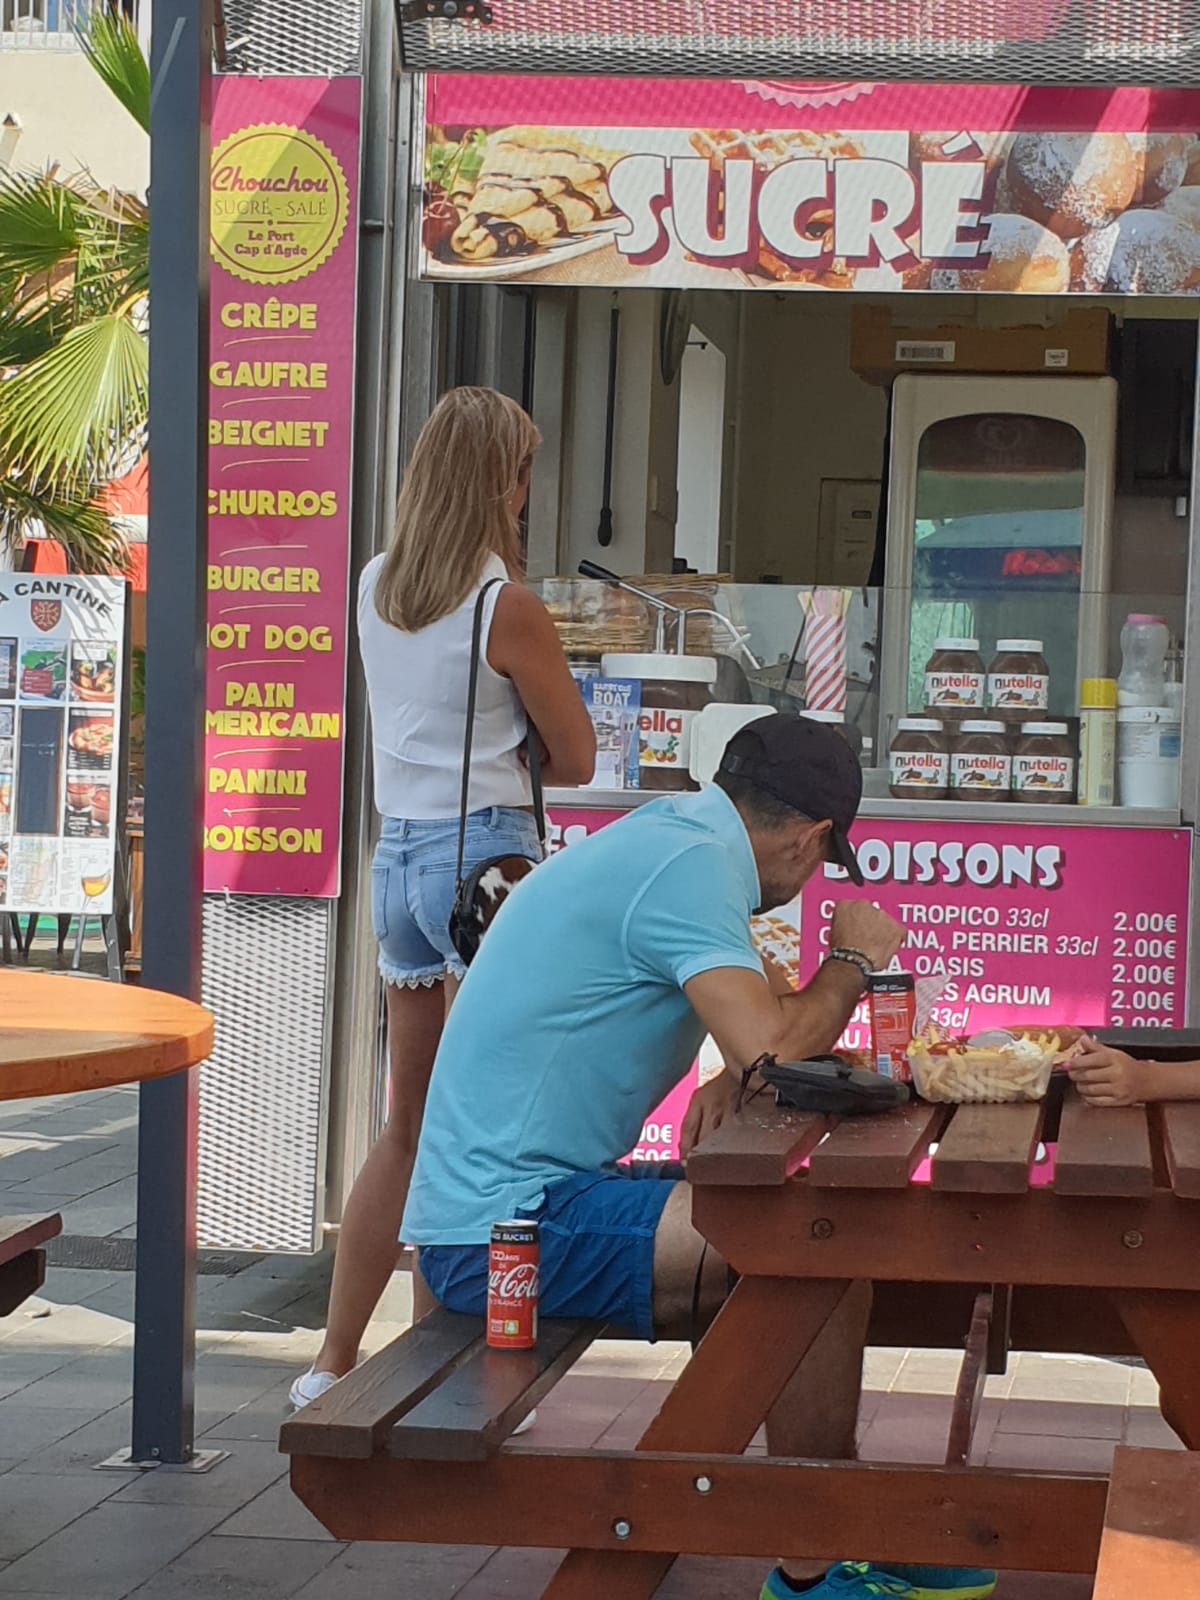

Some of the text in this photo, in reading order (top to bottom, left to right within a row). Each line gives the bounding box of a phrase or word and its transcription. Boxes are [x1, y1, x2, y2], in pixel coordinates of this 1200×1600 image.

[211, 166, 329, 192] Chouchou
[214, 198, 272, 216] SUCRÉ
[286, 198, 328, 216] SALÉ
[606, 129, 990, 266] SUCRÉ
[248, 230, 295, 241] Le Port
[234, 244, 308, 258] Cap d'Agde
[220, 296, 318, 329] CRÊPE
[209, 361, 328, 388] GAUFRE
[208, 419, 329, 447] BEIGNET
[207, 565, 321, 593] BURGER
[14, 581, 113, 618] CANTINE
[207, 622, 333, 651] OT DOG
[931, 675, 979, 688] nutella
[995, 675, 1042, 689] nutella
[225, 681, 295, 708] PAIN
[592, 691, 631, 707] BOAT
[205, 710, 340, 738] MERICAIN
[639, 710, 683, 734] ella
[895, 755, 942, 768] nutella
[958, 757, 1006, 770] nutella
[1019, 759, 1068, 772] nutella
[208, 768, 307, 795] PANINI
[204, 825, 323, 853] OISSON
[898, 903, 1000, 926] TROPICO
[1005, 907, 1050, 928] 33cl
[1113, 911, 1177, 933] 2.00€
[952, 932, 1049, 954] PERRIER
[1055, 935, 1099, 956] 33cl
[1112, 937, 1177, 959] 2.00€
[915, 955, 984, 977] OASIS
[1111, 963, 1176, 985] 2.00€
[965, 984, 1051, 1006] AGRUM
[1110, 989, 1175, 1011] 2.00€
